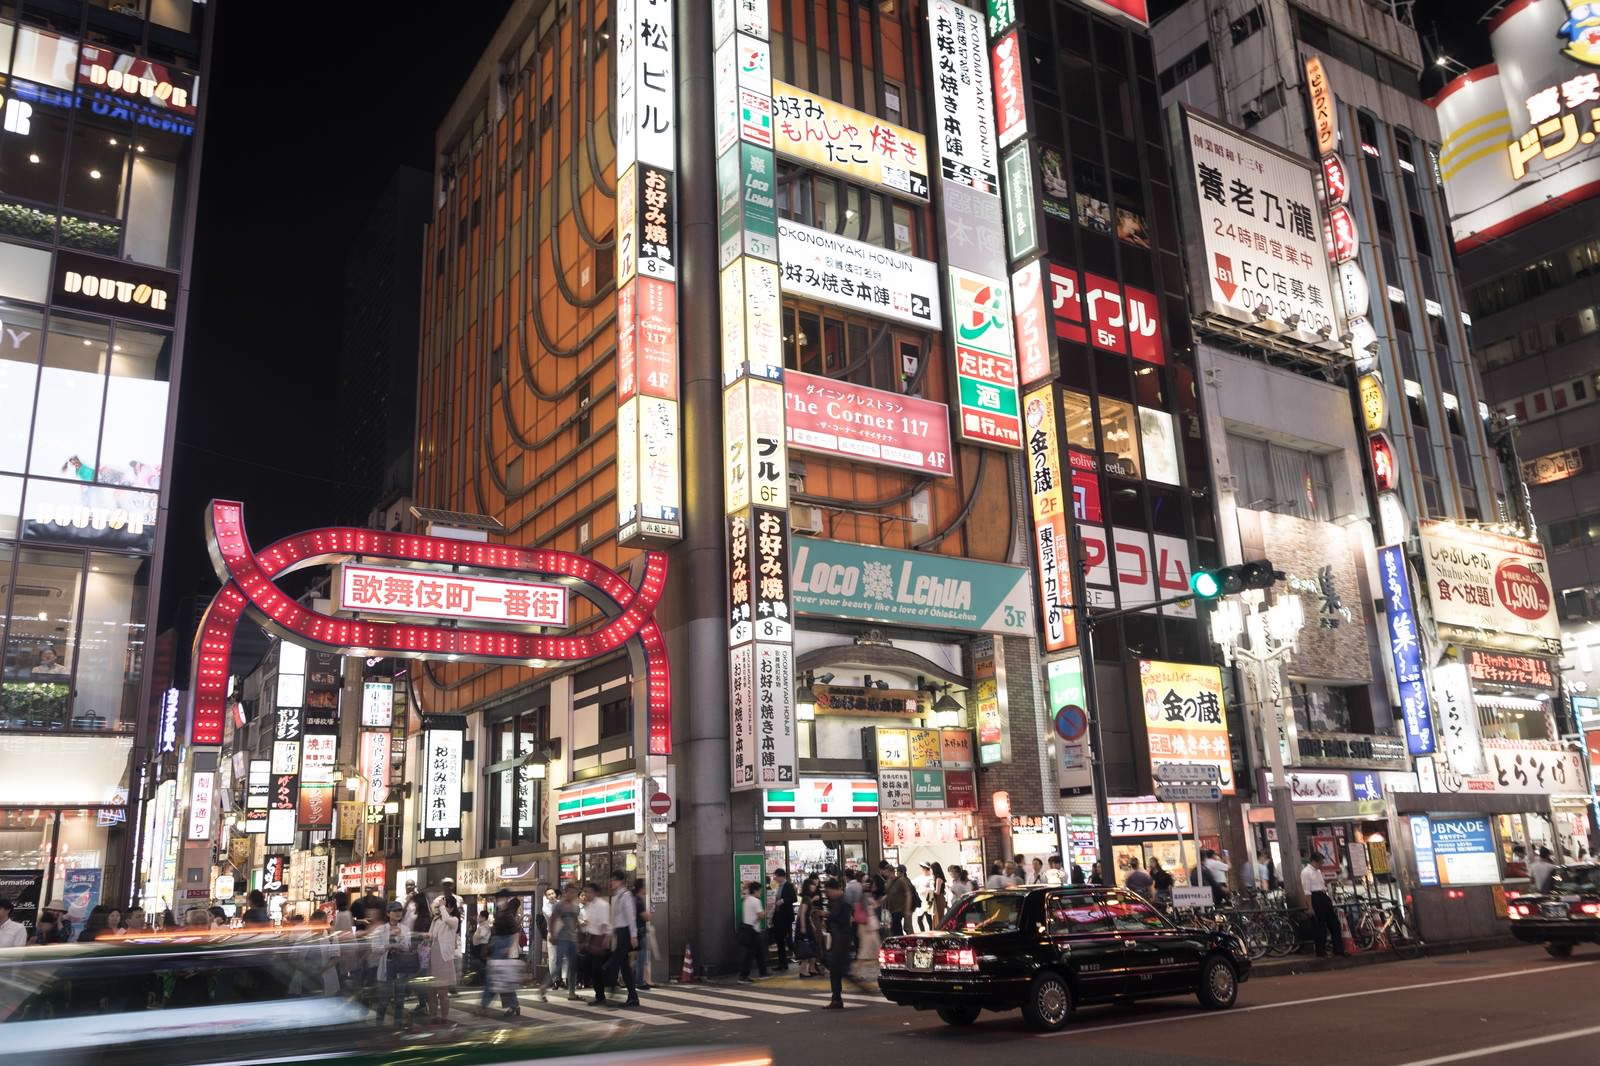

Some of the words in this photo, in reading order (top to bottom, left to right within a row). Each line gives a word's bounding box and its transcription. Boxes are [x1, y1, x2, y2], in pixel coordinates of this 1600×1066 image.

[639, 0, 670, 134] 松ビル
[89, 64, 187, 108] DOUTOR
[781, 119, 859, 142] もんじゃ
[870, 124, 917, 166] 焼き
[825, 141, 868, 164] たこ
[911, 176, 928, 196] 7F
[1198, 161, 1317, 243] 養老乃瀧
[751, 238, 770, 256] 3F
[778, 225, 865, 258] OKONOMIYAKI
[868, 251, 913, 273] HONJIN
[1213, 217, 1314, 271] 24時間営業中
[647, 260, 666, 274] 8F
[1217, 268, 1234, 286] B1
[63, 271, 167, 311] DOUTOR
[1049, 272, 1157, 337] アイフル
[911, 298, 931, 316] 2F
[647, 331, 667, 345] 117
[1023, 307, 1041, 365] アコム
[1097, 328, 1116, 347] 5F
[648, 371, 669, 389] 4F
[960, 351, 1014, 384] たばこ
[806, 384, 904, 414] ダイニングレストラン
[976, 383, 1001, 410] 酒
[784, 391, 819, 416] The
[826, 400, 895, 431] Corner
[901, 417, 929, 438] 117
[756, 437, 781, 482] ブル
[927, 450, 946, 469] 4F
[1029, 429, 1053, 495] 金の蔵
[760, 484, 778, 503] 6F
[1040, 496, 1058, 516] 2F
[732, 516, 748, 606] お好み焼
[759, 511, 785, 601] お好み焼
[1429, 542, 1492, 570] しゃぶしゃぶ
[352, 574, 560, 620] 歌舞伎町一番街
[1039, 527, 1061, 641] 東京チカラめし
[1502, 580, 1538, 611] 1,980
[819, 597, 841, 609] your
[842, 598, 873, 611] beauty
[874, 602, 890, 612] like
[899, 605, 916, 616] love
[917, 607, 929, 616] of
[1004, 605, 1027, 628] 3F
[763, 620, 784, 637] 8F
[761, 659, 775, 768] お好み焼き本陣
[1162, 688, 1222, 725] 金の蔵
[779, 768, 792, 780] 2F
